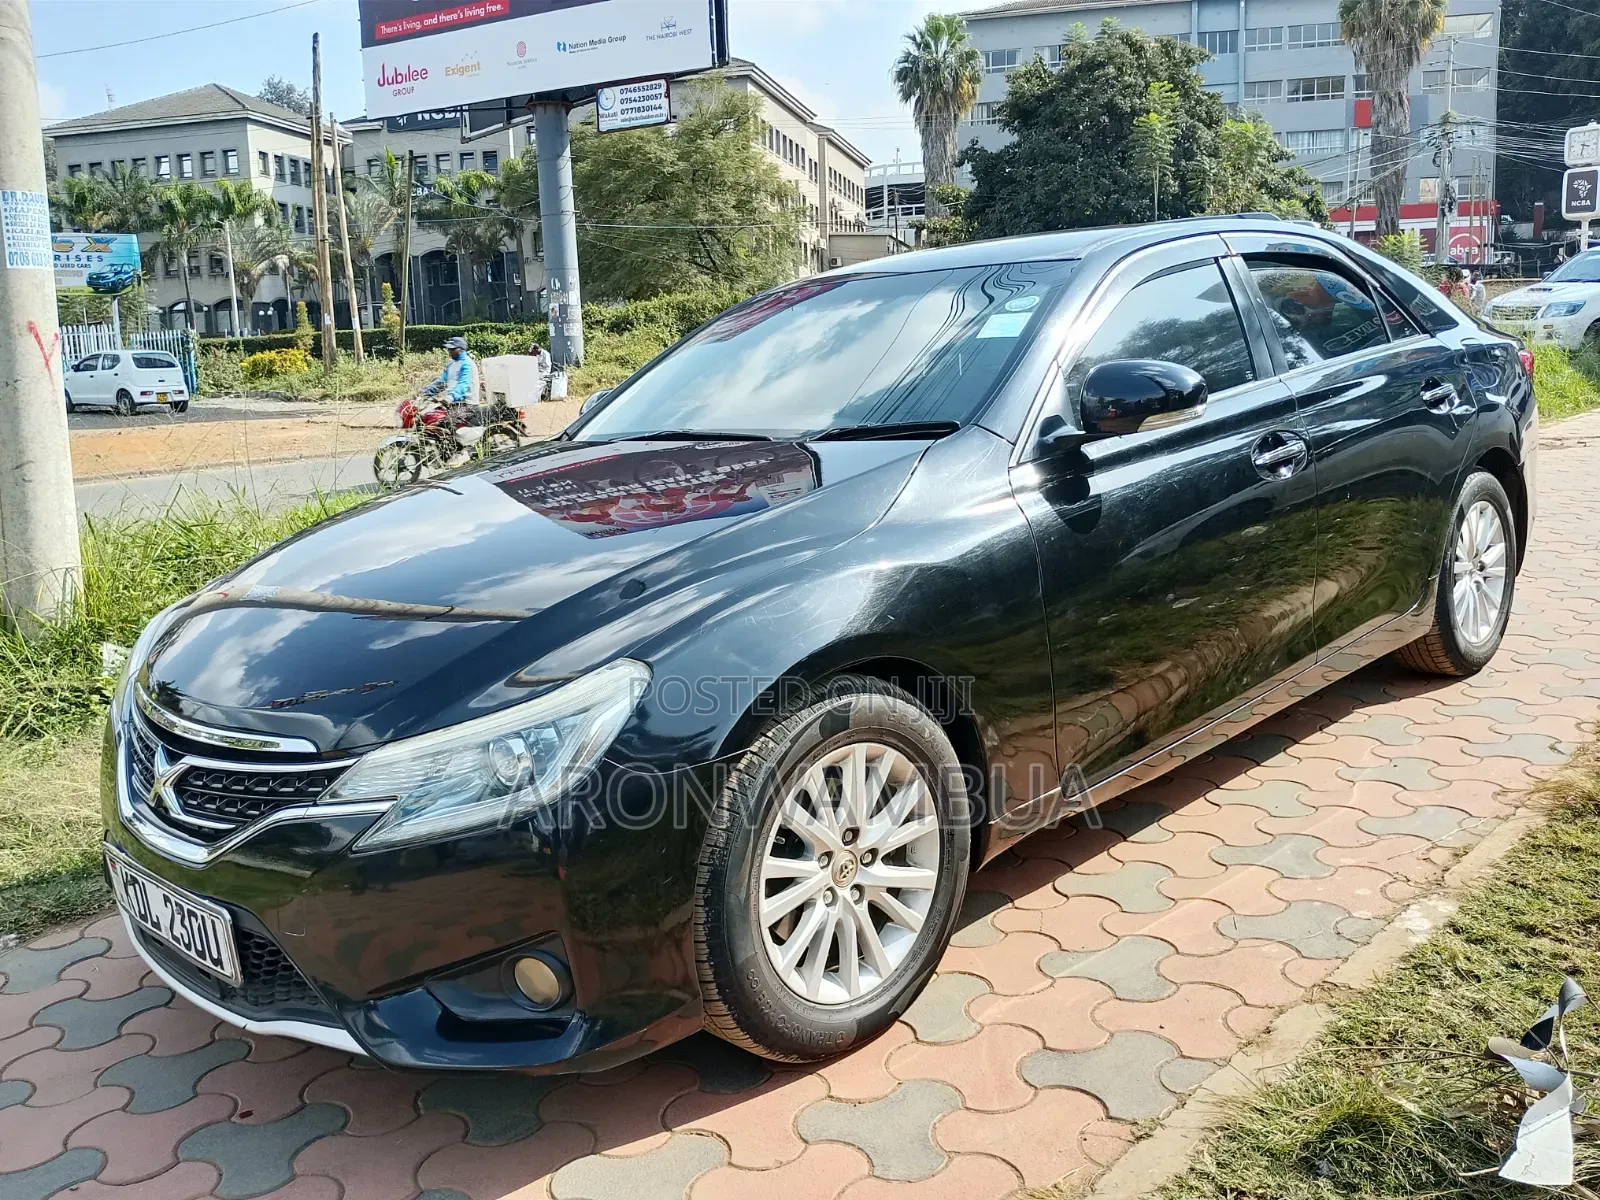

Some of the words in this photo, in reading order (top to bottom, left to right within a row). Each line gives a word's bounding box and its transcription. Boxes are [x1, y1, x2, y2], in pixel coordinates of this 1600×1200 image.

[380, 23, 402, 35] There's
[403, 20, 422, 31] living,
[423, 16, 438, 26] and
[439, 11, 463, 24] there's
[464, 6, 485, 18] living
[486, 2, 504, 14] free.
[568, 41, 588, 50] Nation
[588, 37, 606, 47] Media
[607, 34, 627, 46] Group
[377, 62, 429, 88] Jubilee
[444, 62, 481, 77] Exigent
[392, 85, 415, 98] GROUP
[620, 83, 662, 95] 0746552829
[620, 93, 663, 105] 0754230057
[620, 104, 663, 116] 0771830144
[1570, 199, 1591, 207] NCBA
[163, 893, 225, 971] 230U
